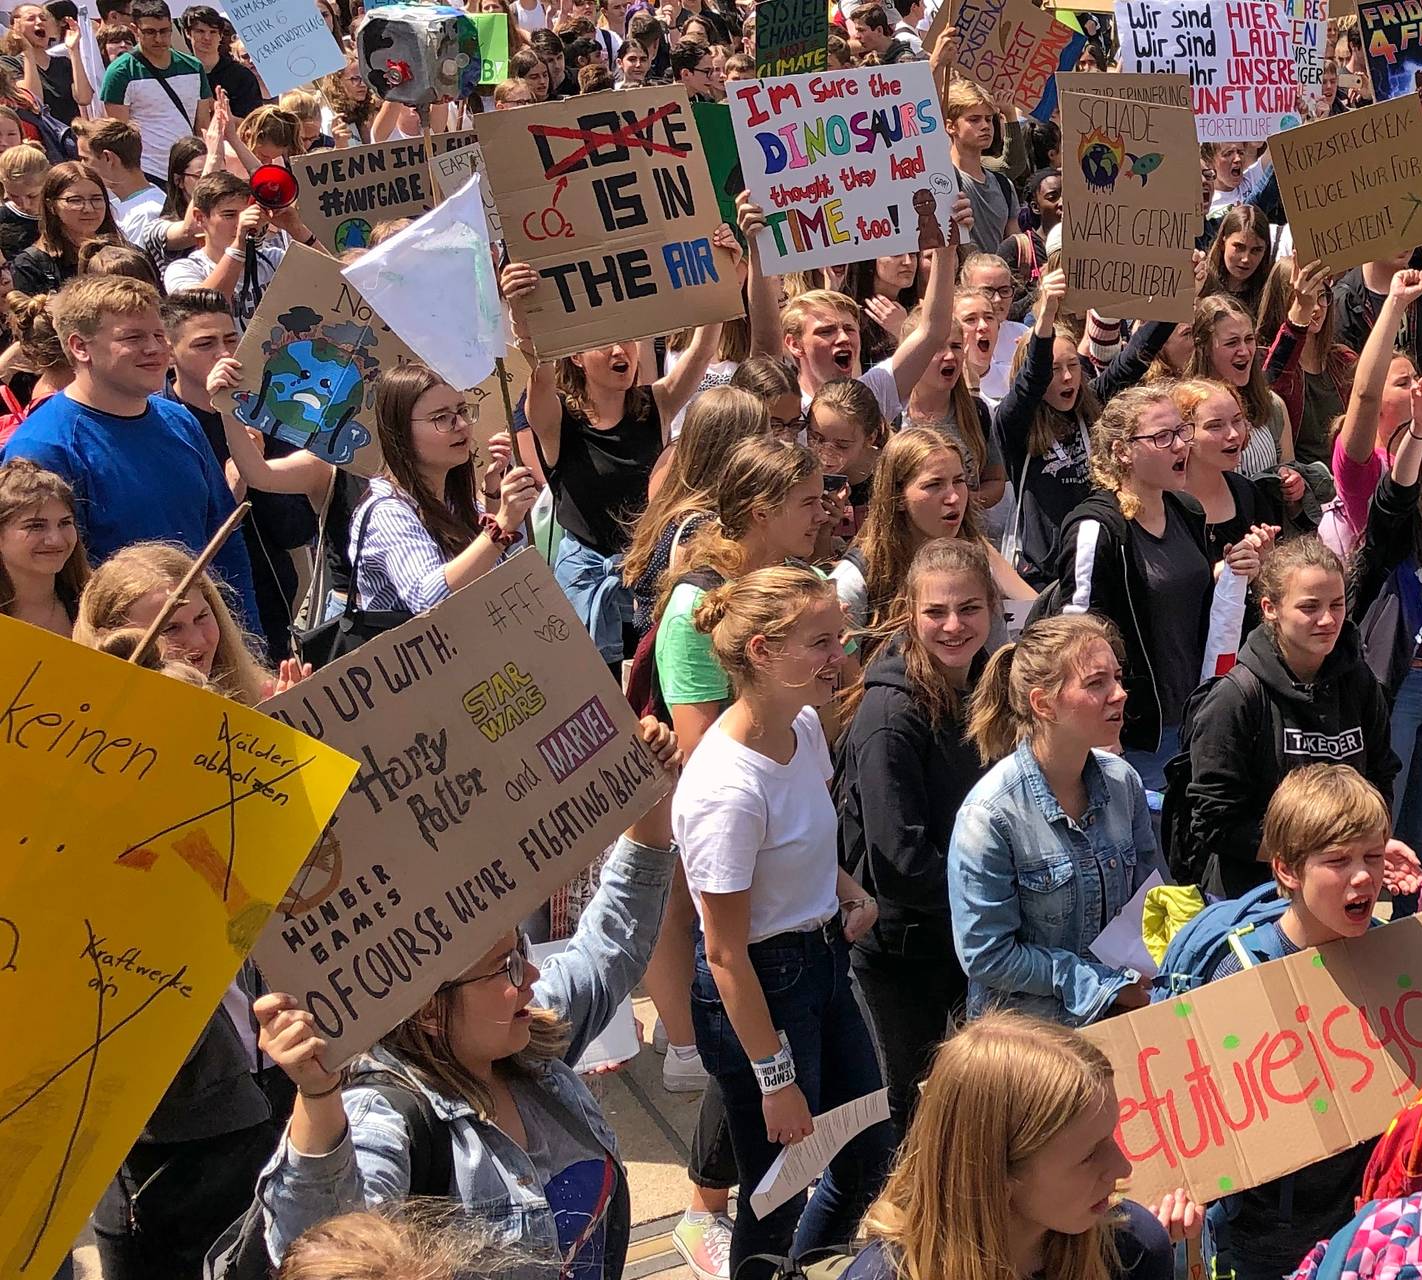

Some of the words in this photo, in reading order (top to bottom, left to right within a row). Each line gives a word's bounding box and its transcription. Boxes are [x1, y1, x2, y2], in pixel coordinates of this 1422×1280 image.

[1127, 2, 1162, 30] Wir
[1171, 2, 1213, 29] sind
[1225, 2, 1282, 30] HIER
[1132, 30, 1169, 58] Wir
[1229, 28, 1291, 58] LAUT
[1188, 59, 1218, 85] ihr
[1226, 58, 1298, 86] UNSERE
[1369, 29, 1398, 65] 4
[736, 78, 802, 128] I'm
[867, 72, 902, 99] the
[1076, 98, 1161, 145] SCHADE
[1190, 85, 1250, 115] UNFT
[754, 98, 938, 176] DINOSAURS
[304, 148, 386, 188] WENN
[319, 172, 426, 219] #AUFGABE
[769, 173, 834, 209] thought
[838, 166, 877, 193] they
[889, 144, 926, 182] had
[1293, 179, 1348, 212] FLÜGE
[591, 171, 649, 233] IS
[652, 165, 696, 221] IN
[1131, 207, 1194, 251] GERNE
[538, 248, 658, 314] THE
[661, 237, 721, 291] AIR
[322, 665, 376, 723] UP
[461, 661, 534, 725] STAR
[478, 684, 547, 744] WARS
[349, 727, 449, 815] Harry
[504, 757, 542, 803] and
[540, 697, 616, 780] MARVEL
[406, 766, 488, 853] Potter
[282, 864, 392, 954] HUNGER
[304, 966, 359, 1039] OF
[352, 905, 453, 999] COURSE
[445, 857, 518, 925] WE'RE
[518, 778, 612, 873] FIGHTING
[311, 888, 402, 965] GAMES
[763, 1067, 795, 1088] TEMPO
